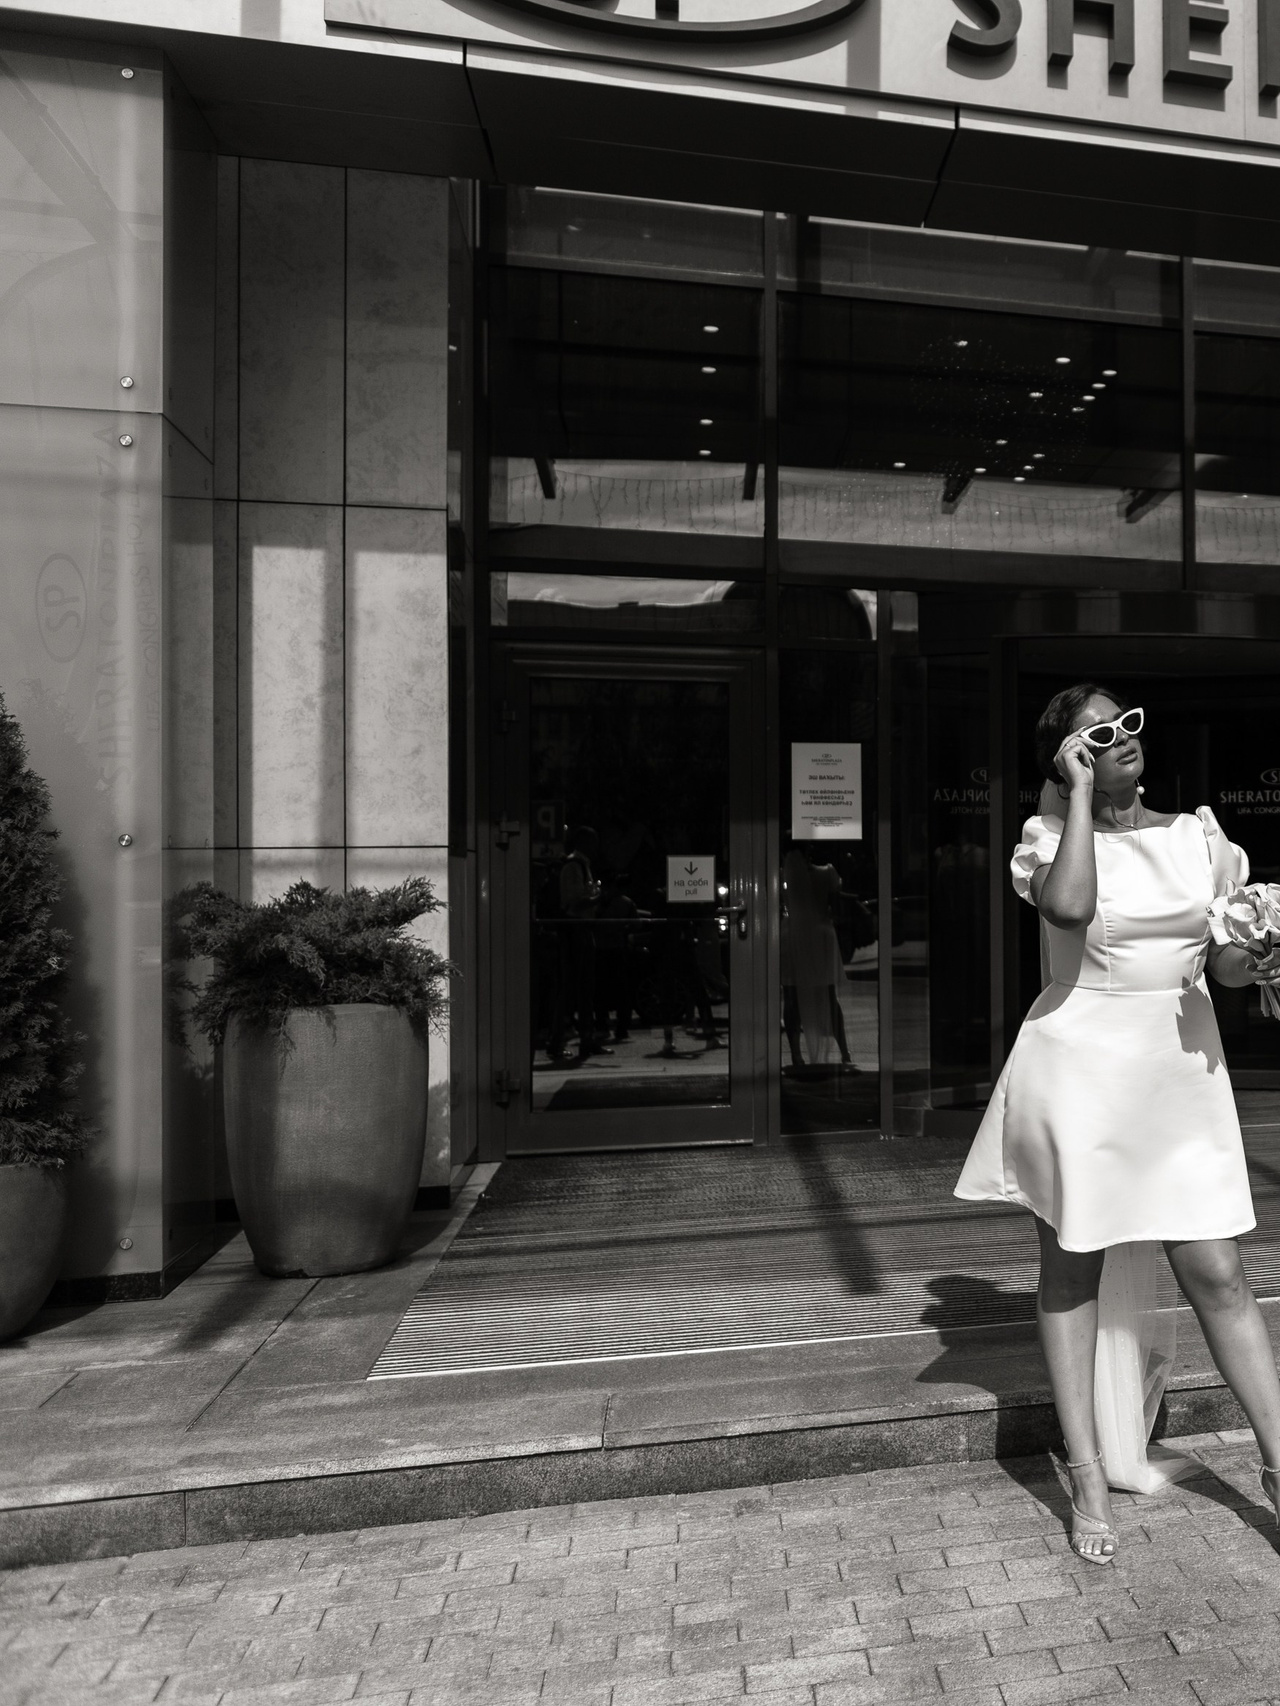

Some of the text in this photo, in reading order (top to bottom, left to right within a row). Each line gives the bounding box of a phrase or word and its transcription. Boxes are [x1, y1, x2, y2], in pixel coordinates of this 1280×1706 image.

[673, 877, 709, 887] на себя
[684, 888, 698, 897] pull
